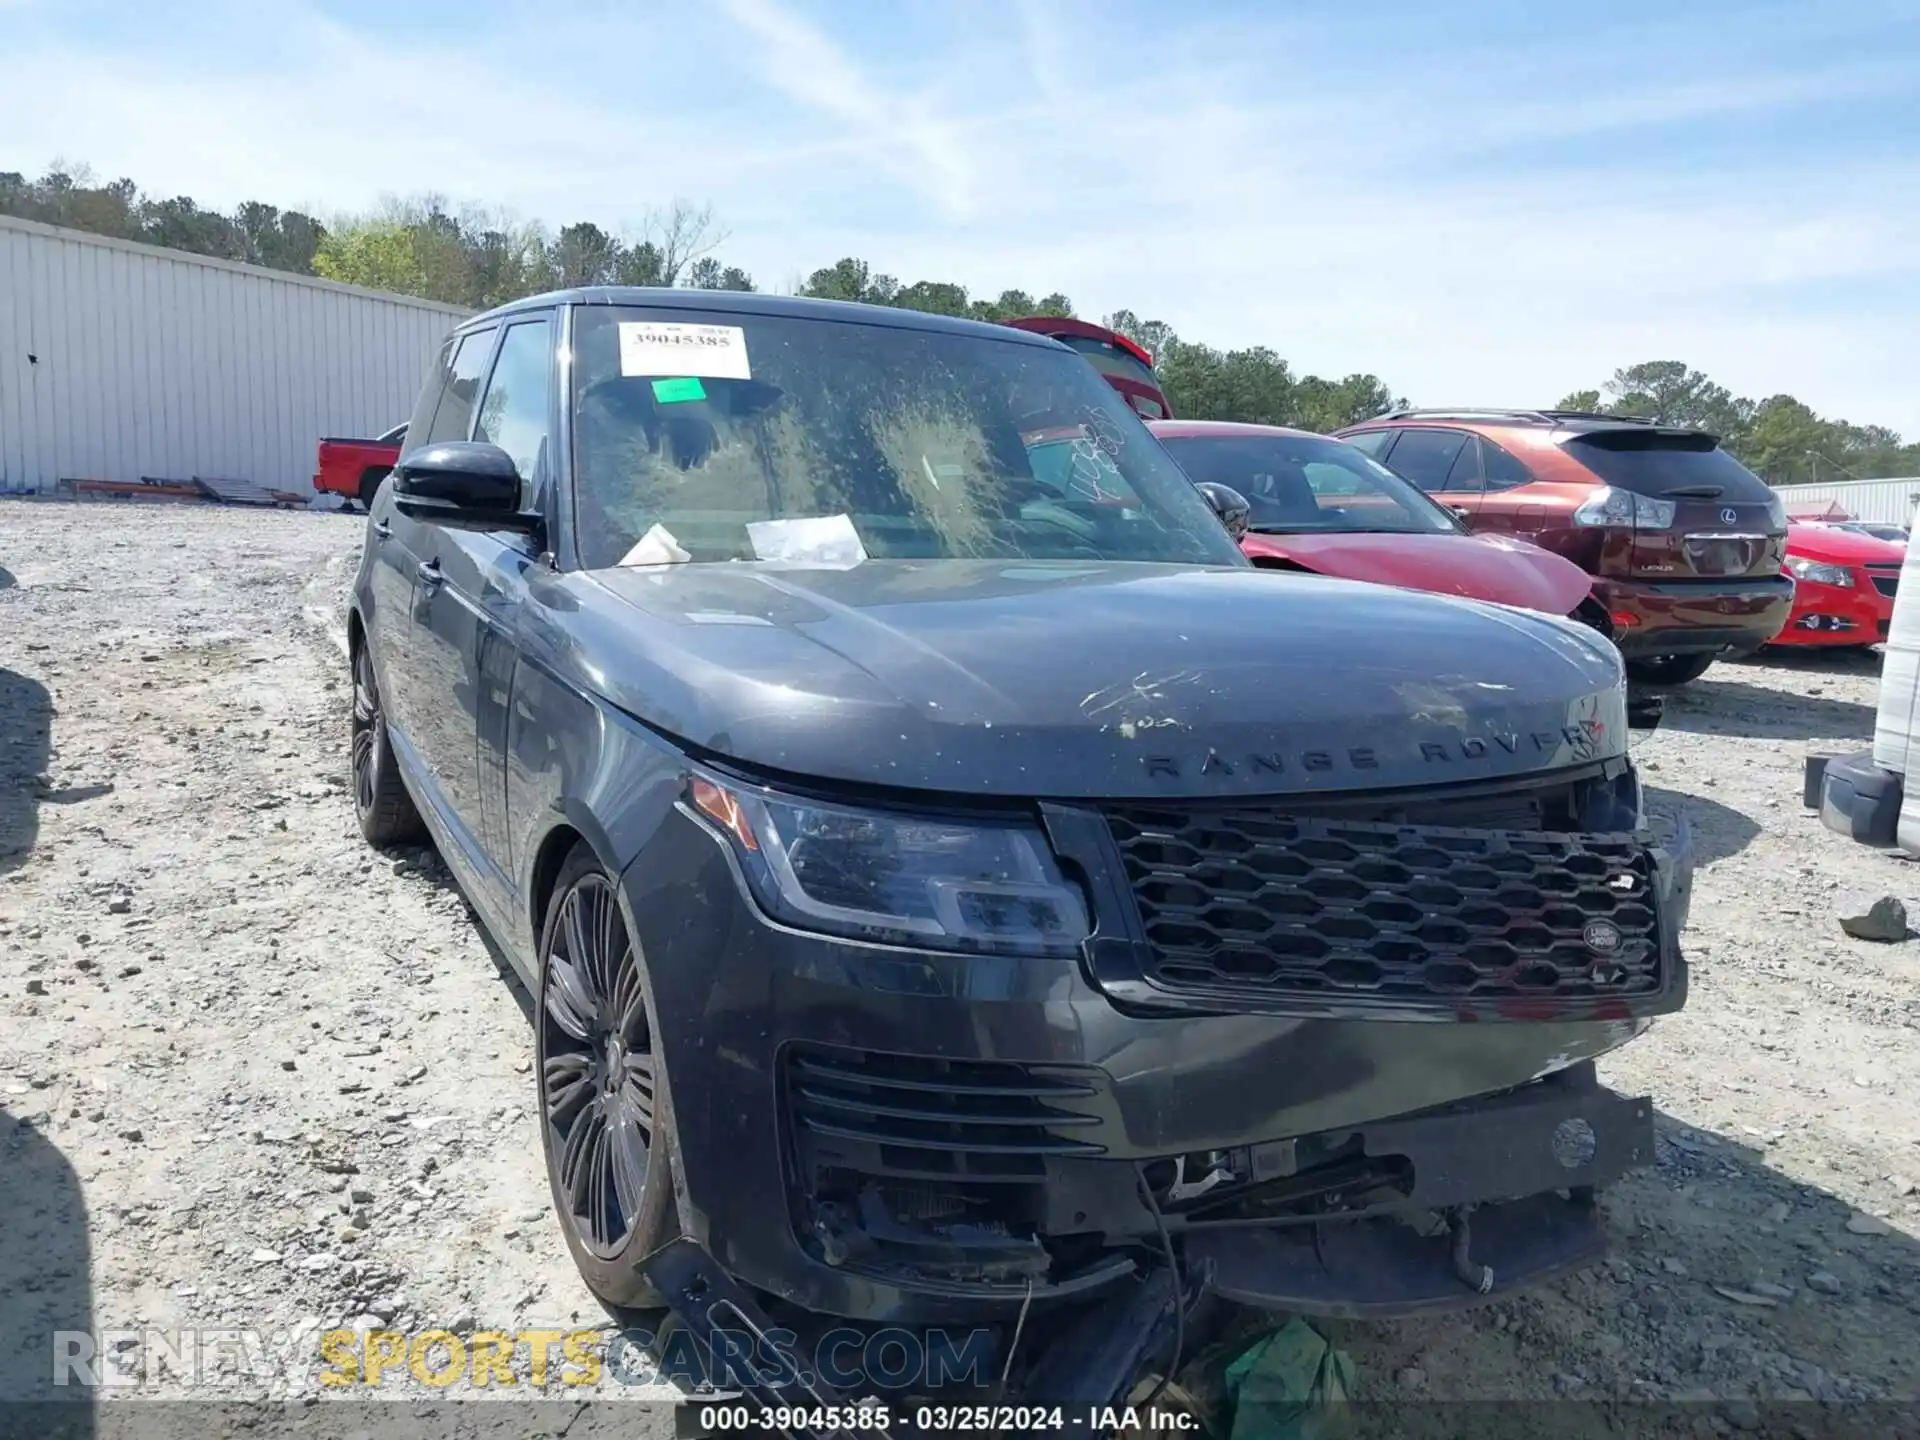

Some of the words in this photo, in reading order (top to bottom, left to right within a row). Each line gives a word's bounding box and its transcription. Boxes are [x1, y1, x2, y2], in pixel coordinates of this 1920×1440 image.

[633, 332, 731, 348] 39045385
[1145, 748, 1380, 778] RANGE
[1418, 722, 1588, 763] ROVER
